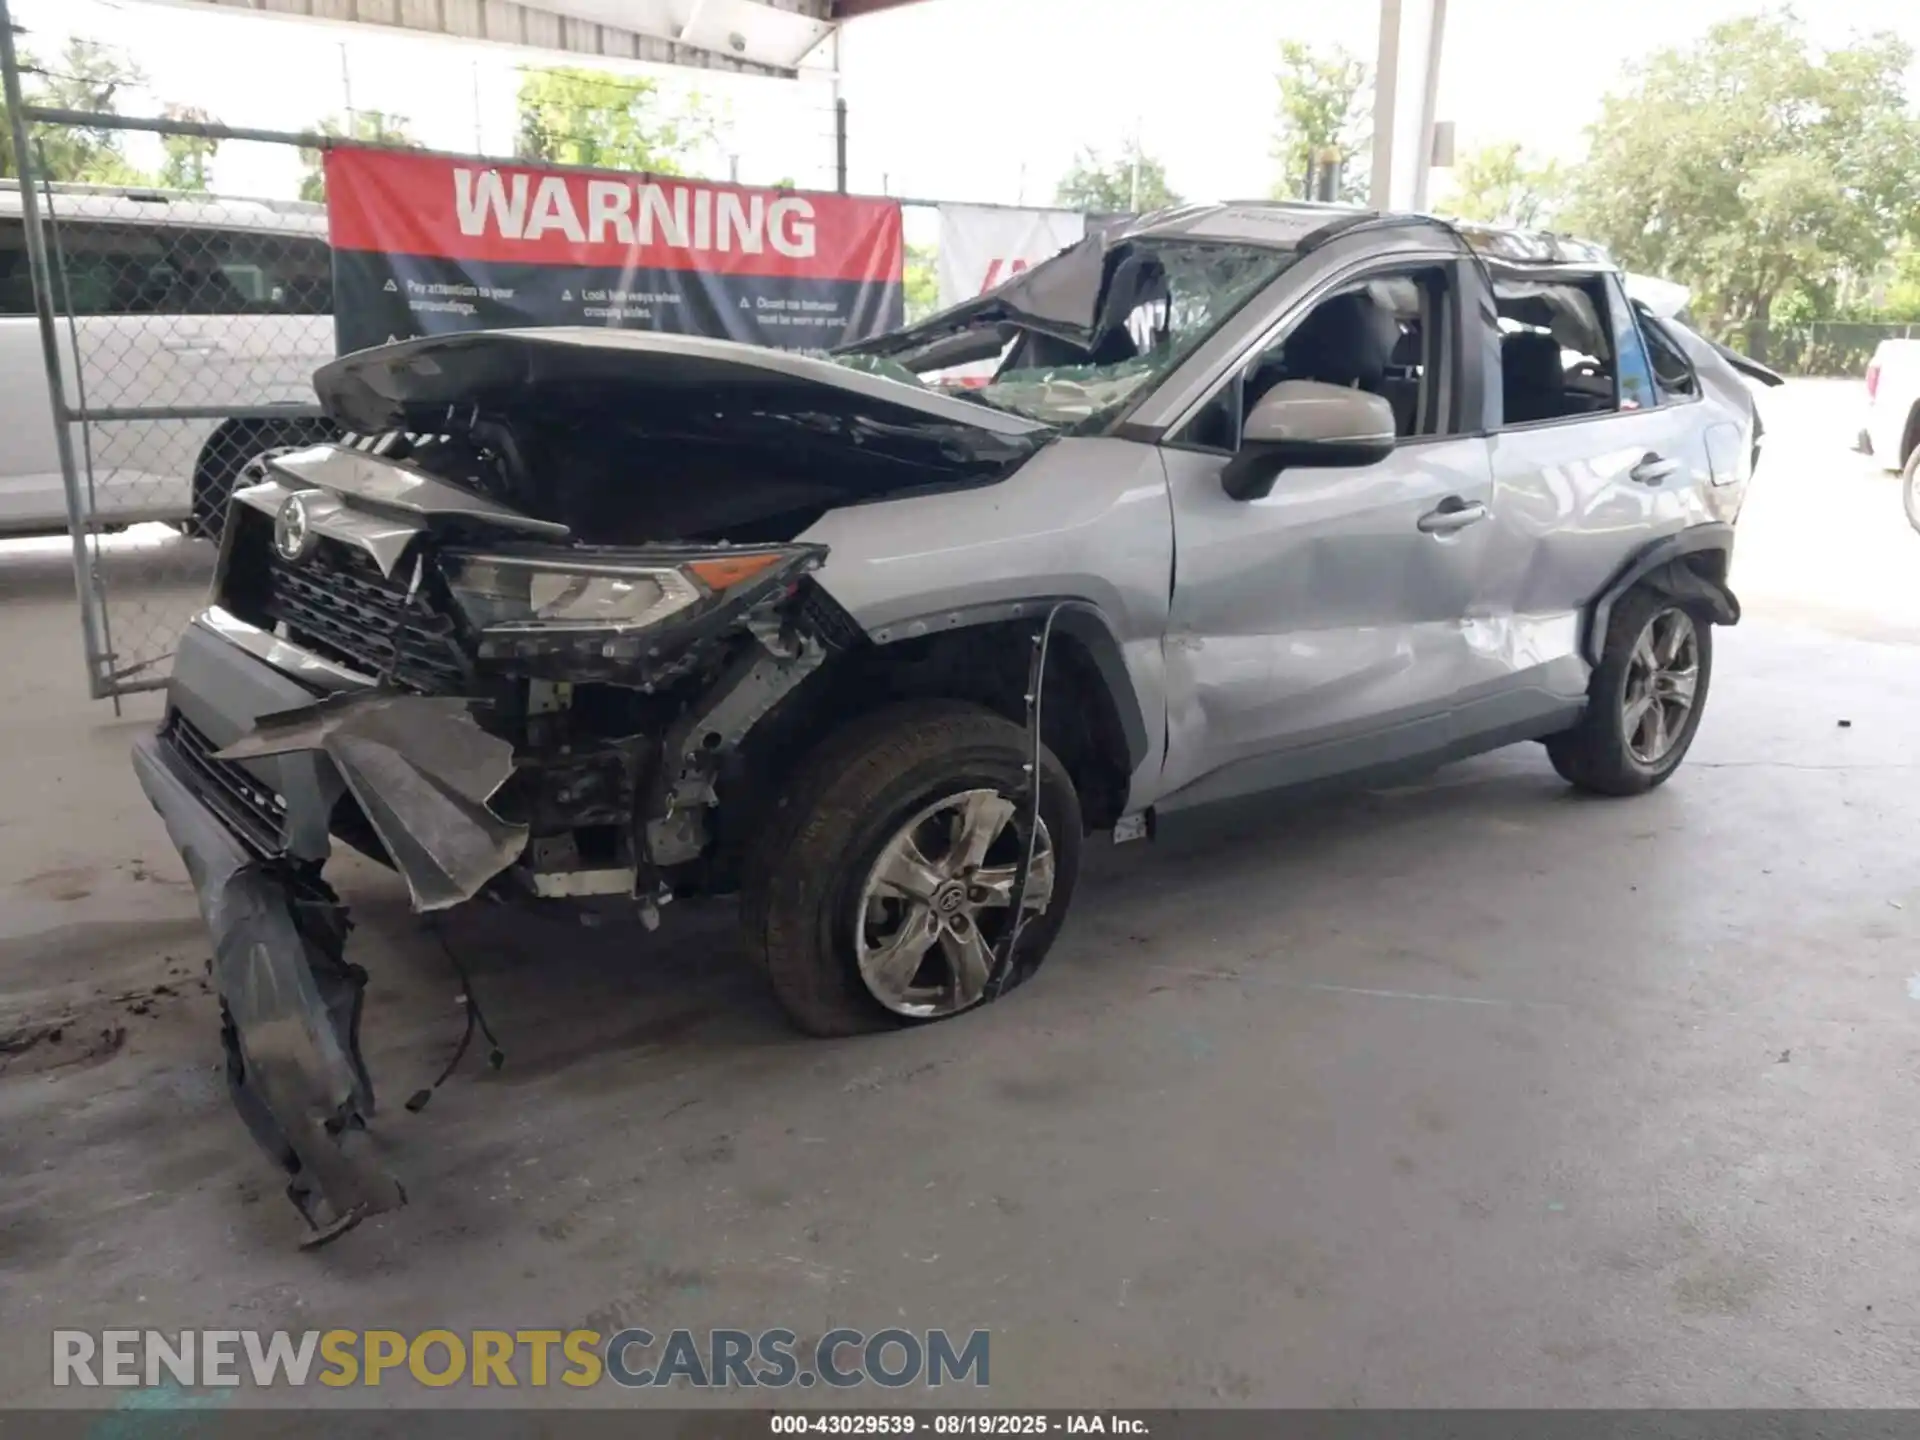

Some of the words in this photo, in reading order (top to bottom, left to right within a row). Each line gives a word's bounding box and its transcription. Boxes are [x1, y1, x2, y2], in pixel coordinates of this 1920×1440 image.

[454, 168, 816, 257] WARNING
[407, 280, 426, 295] Pay
[428, 283, 477, 296] attention
[479, 286, 490, 297] to
[581, 289, 606, 300] Look
